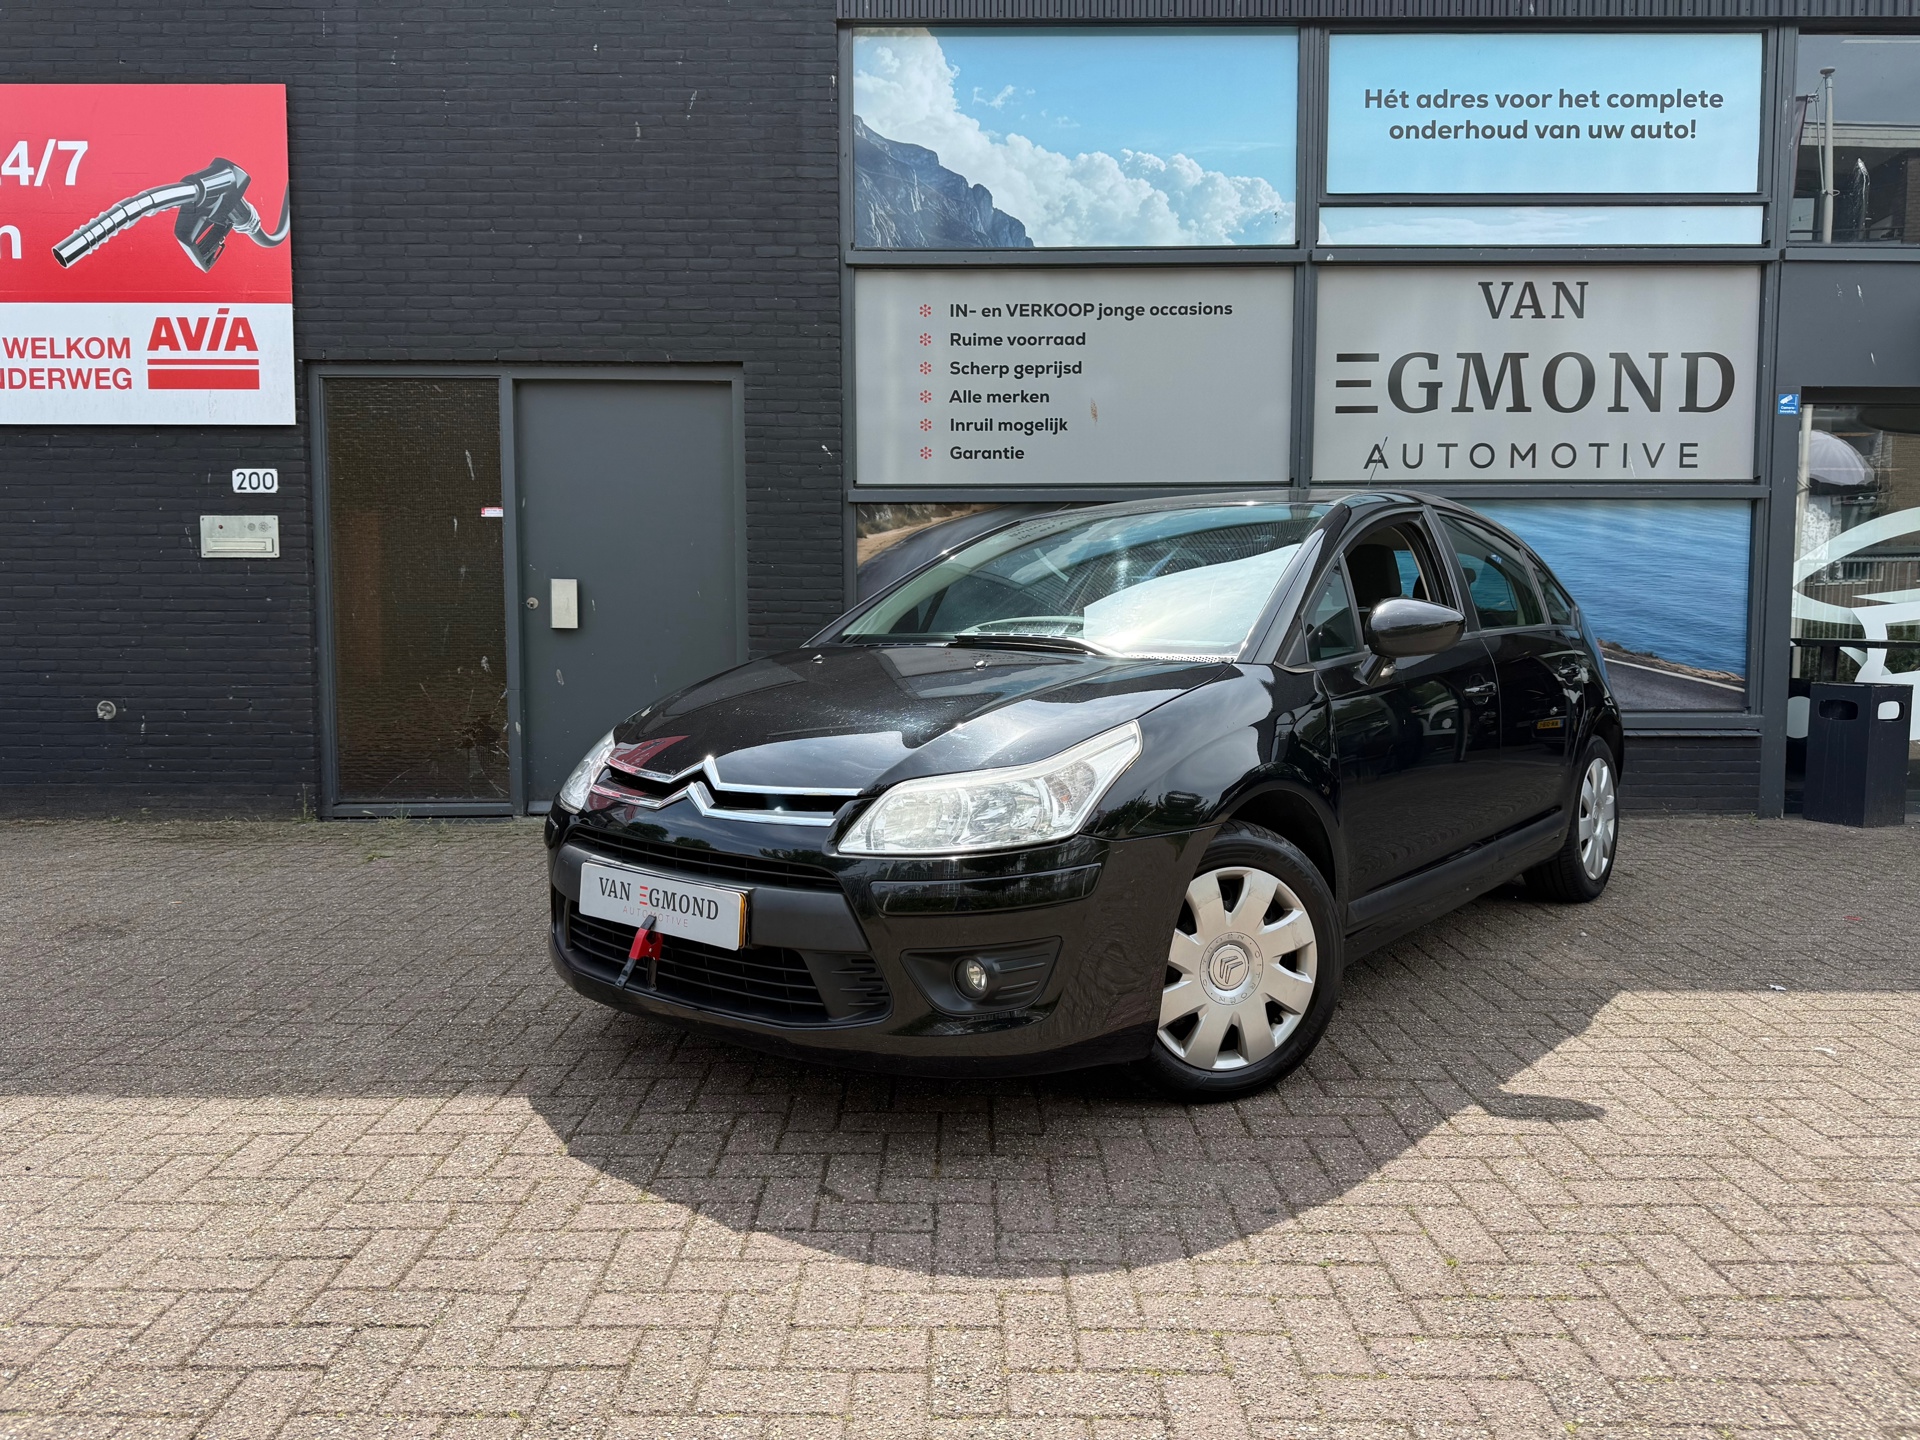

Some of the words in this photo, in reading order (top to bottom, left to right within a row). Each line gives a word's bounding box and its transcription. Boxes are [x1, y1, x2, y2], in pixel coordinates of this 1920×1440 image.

[1364, 88, 1410, 109] Hét
[1416, 88, 1489, 109] adres
[1494, 93, 1553, 109] voor
[1558, 88, 1600, 109] het
[1606, 88, 1724, 114] complete
[1389, 119, 1528, 140] onderhoud
[1534, 124, 1581, 140] van
[1588, 124, 1625, 139] uw
[1630, 119, 1697, 139] auto!
[0, 138, 88, 187] 4/7
[1477, 281, 1589, 319] VAN
[949, 303, 977, 318] IN-
[981, 307, 1002, 318] en
[1005, 302, 1095, 318] VERKOOP
[1096, 302, 1146, 321] jonge
[1149, 301, 1233, 316] occasions
[2, 337, 131, 359] WELKOM
[950, 332, 1003, 347] Ruime
[1006, 331, 1086, 347] voorraad
[949, 361, 1010, 379] Scherp
[1013, 360, 1083, 380] geprijsd
[1334, 351, 1736, 414] EGMOND
[948, 389, 982, 404] Alle
[986, 389, 1050, 404] merken
[949, 417, 993, 432] Inruil
[998, 417, 1068, 436] mogelijk
[949, 445, 1025, 460] Garantie
[1363, 442, 1699, 469] AUTOMOTIVE
[236, 471, 275, 491] 200
[598, 876, 631, 902] VAN
[639, 885, 719, 920] EGMOND
